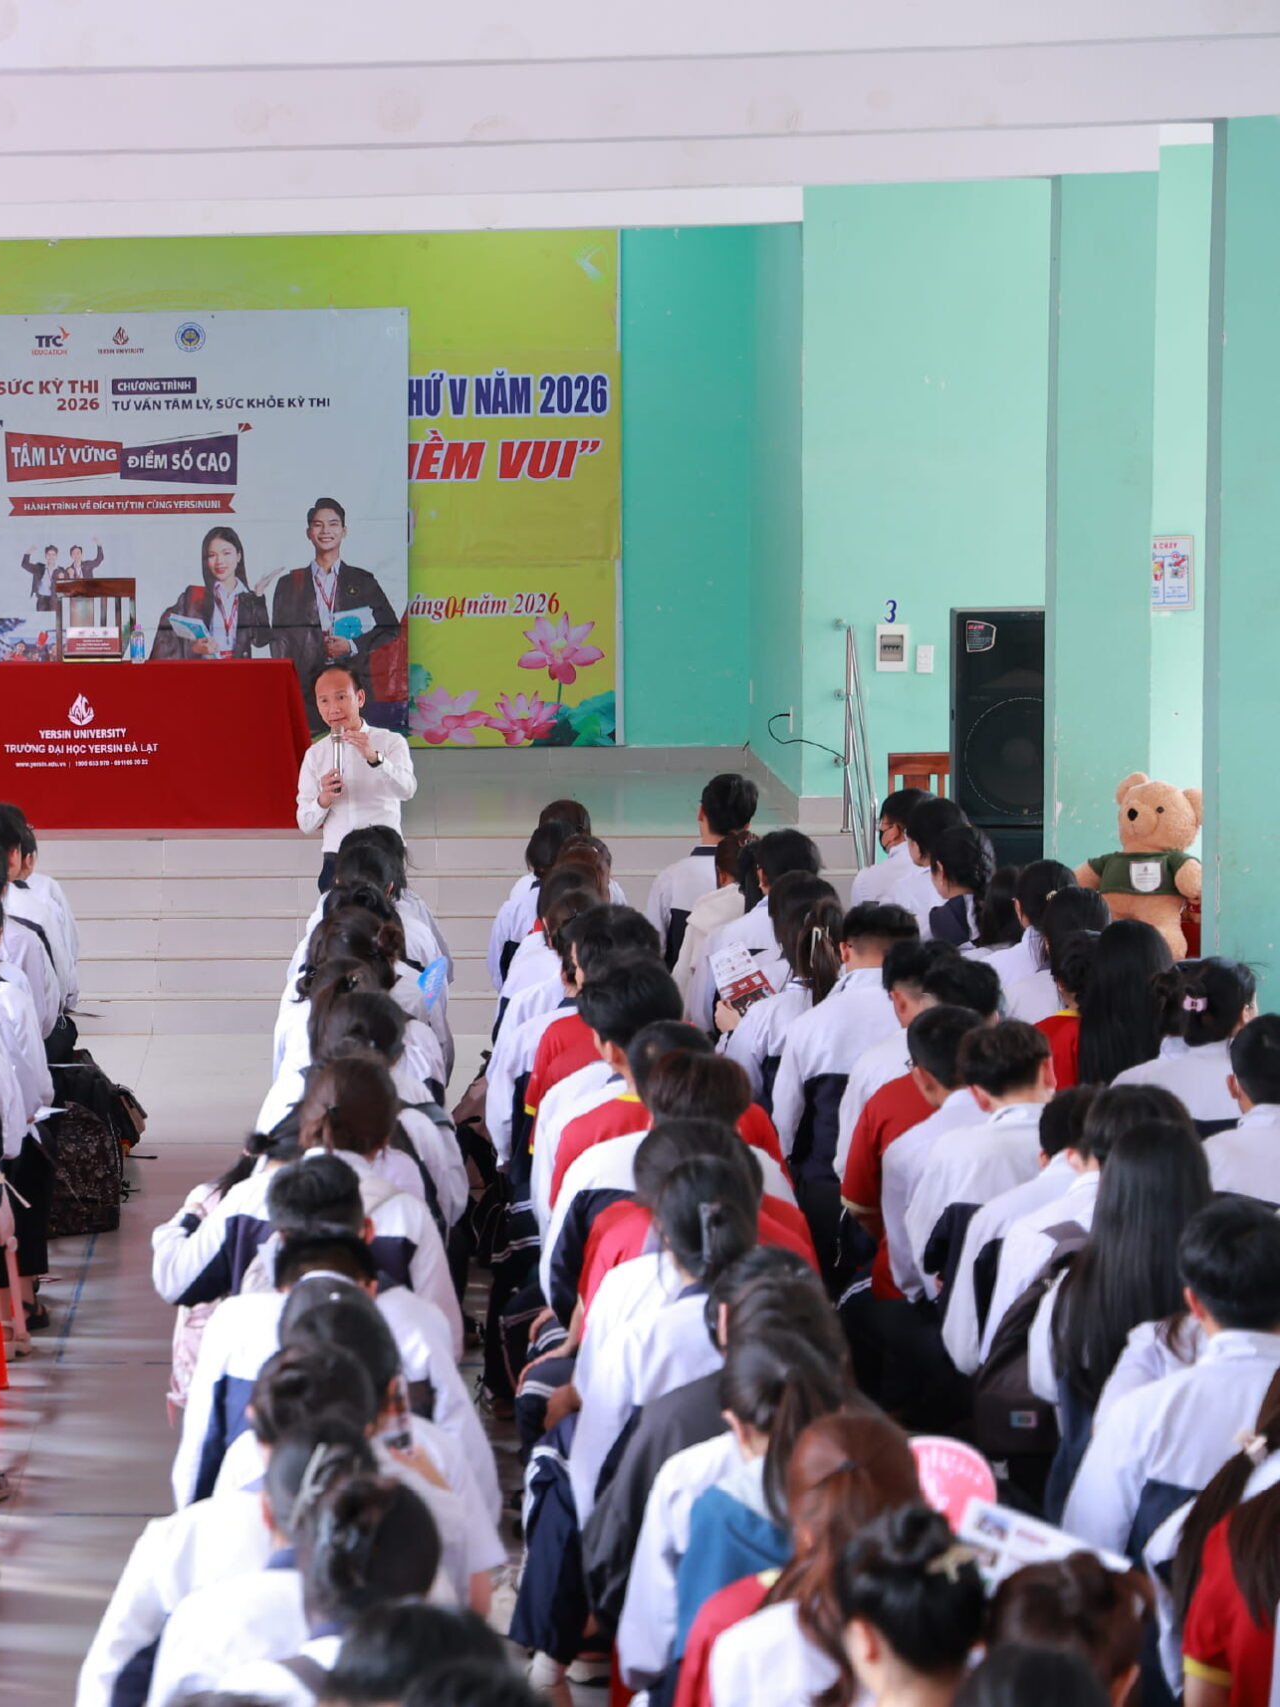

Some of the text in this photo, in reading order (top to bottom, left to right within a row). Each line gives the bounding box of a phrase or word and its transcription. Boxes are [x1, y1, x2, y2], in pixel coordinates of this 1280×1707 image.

[35, 336, 63, 348] TTC
[39, 377, 63, 394] KỲ
[68, 380, 98, 393] THI
[118, 381, 191, 391] CHƯƠNG TRÌNH
[449, 379, 467, 415] V
[475, 370, 531, 415] NĂM
[540, 375, 607, 413] 2026
[57, 398, 100, 411] 2026
[112, 395, 330, 411] TƯ VẤN TÂM LÝ, SỨC KHỎE KỲ THI
[11, 442, 117, 468] TÂM LÝ VỮNG
[127, 447, 231, 472] ĐIỂM SỐ CAO
[24, 499, 220, 511] HÀNH TRÌNH VỀ ĐÍCH TỰ TIN CÙNG YERSINUNI
[467, 595, 507, 614] năm
[514, 592, 560, 615] 2026
[884, 600, 897, 623] 3
[39, 728, 126, 739] YERSIN UNIVERSITY
[4, 742, 158, 756] TRƯỜNG ĐẠI HỌC YERSIN ĐÀ LẠT
